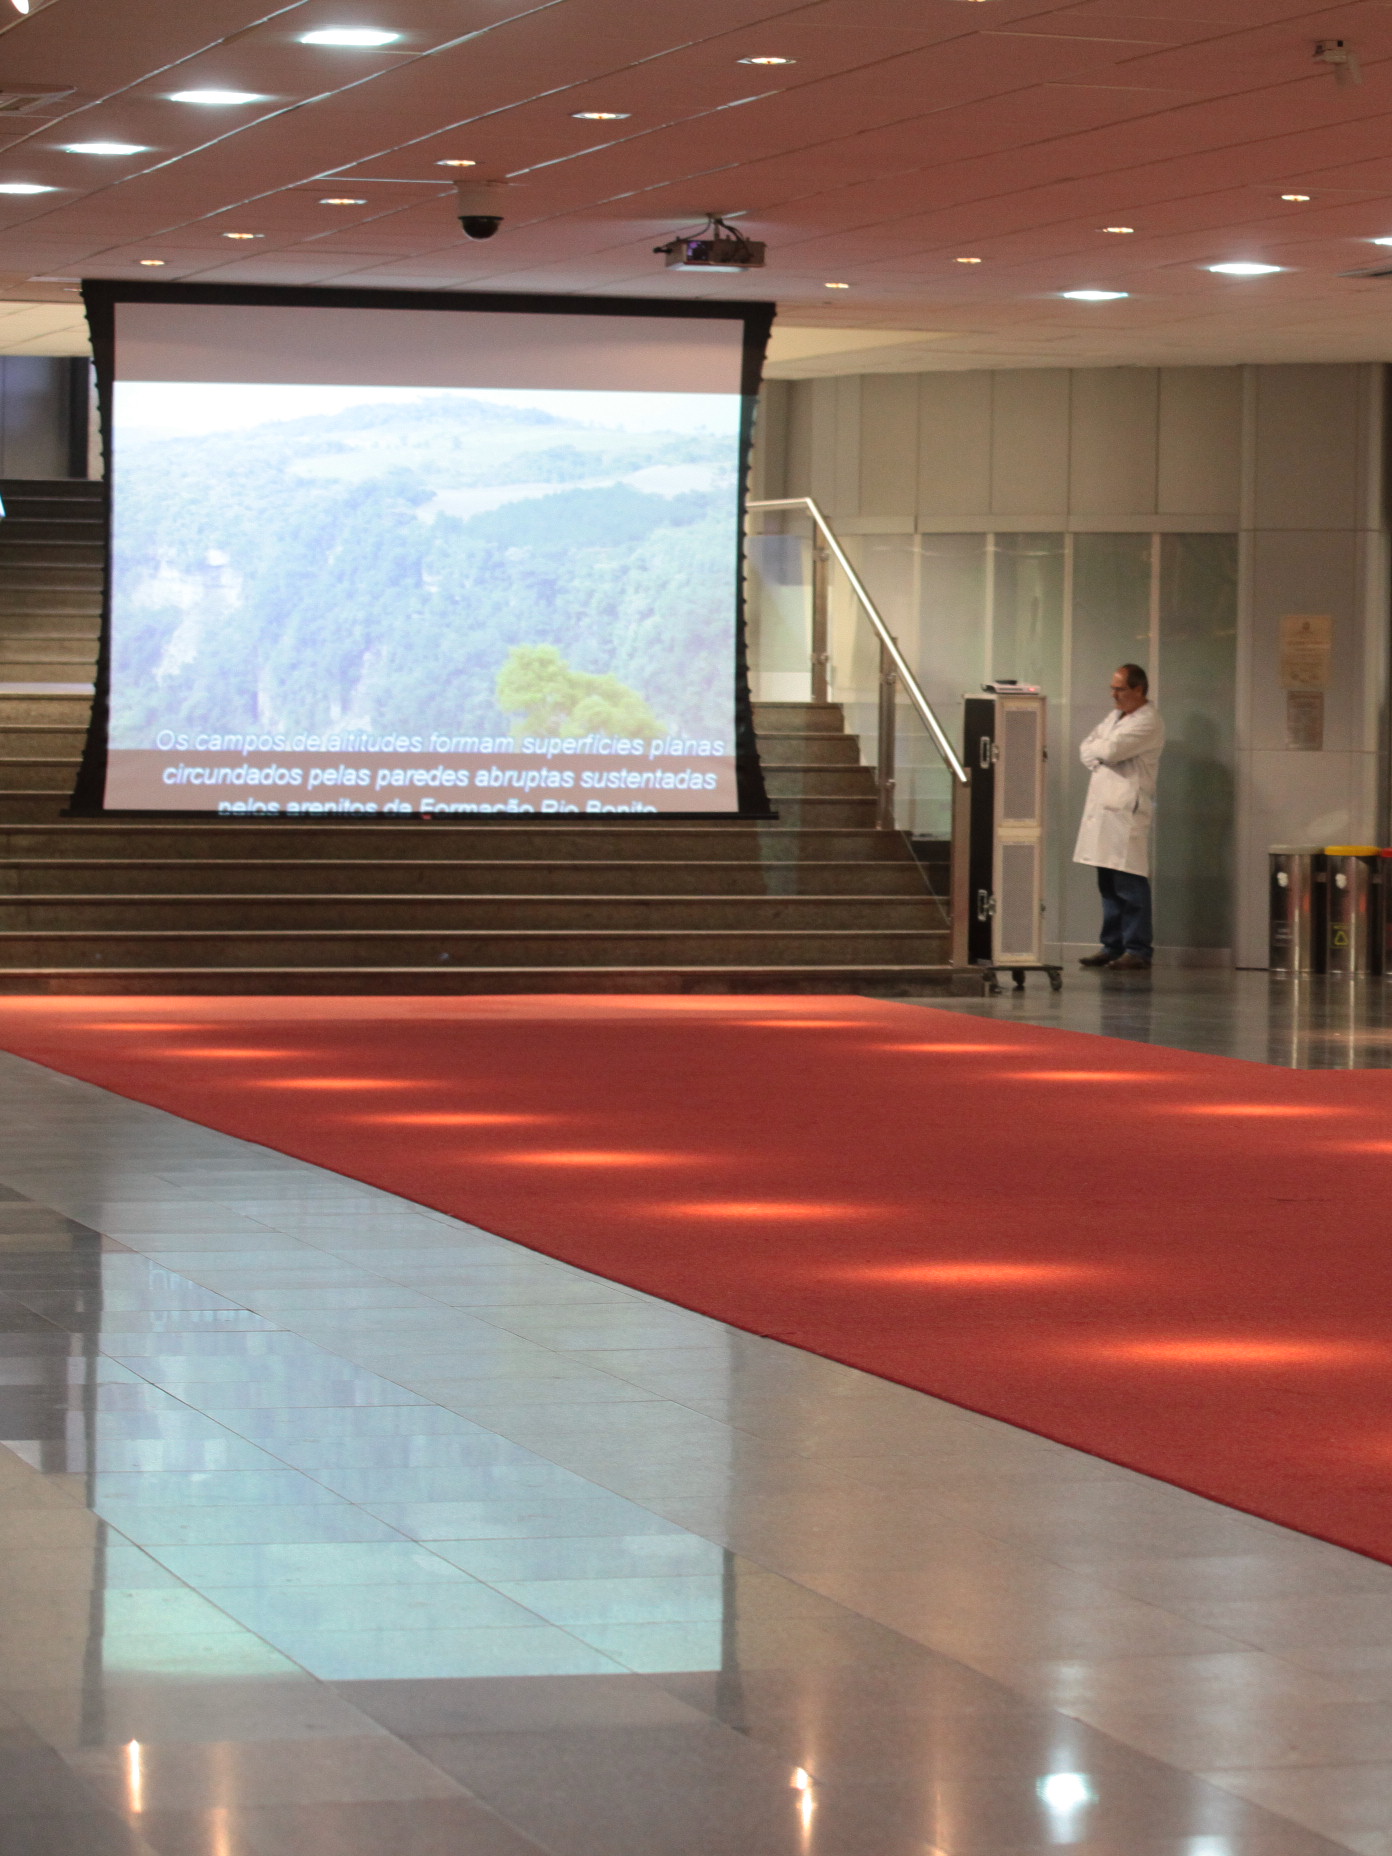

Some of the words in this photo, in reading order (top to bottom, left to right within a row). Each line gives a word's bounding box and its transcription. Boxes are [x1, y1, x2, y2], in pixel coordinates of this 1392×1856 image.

[156, 729, 189, 751] Os
[195, 731, 286, 756] campos
[291, 730, 323, 752] de
[429, 733, 514, 754] formam
[648, 736, 725, 760] planas
[162, 763, 302, 785] circundados
[307, 764, 370, 790] pelas
[375, 765, 469, 791] paredes
[474, 766, 576, 792] abruptas
[580, 767, 718, 790] sustentadas
